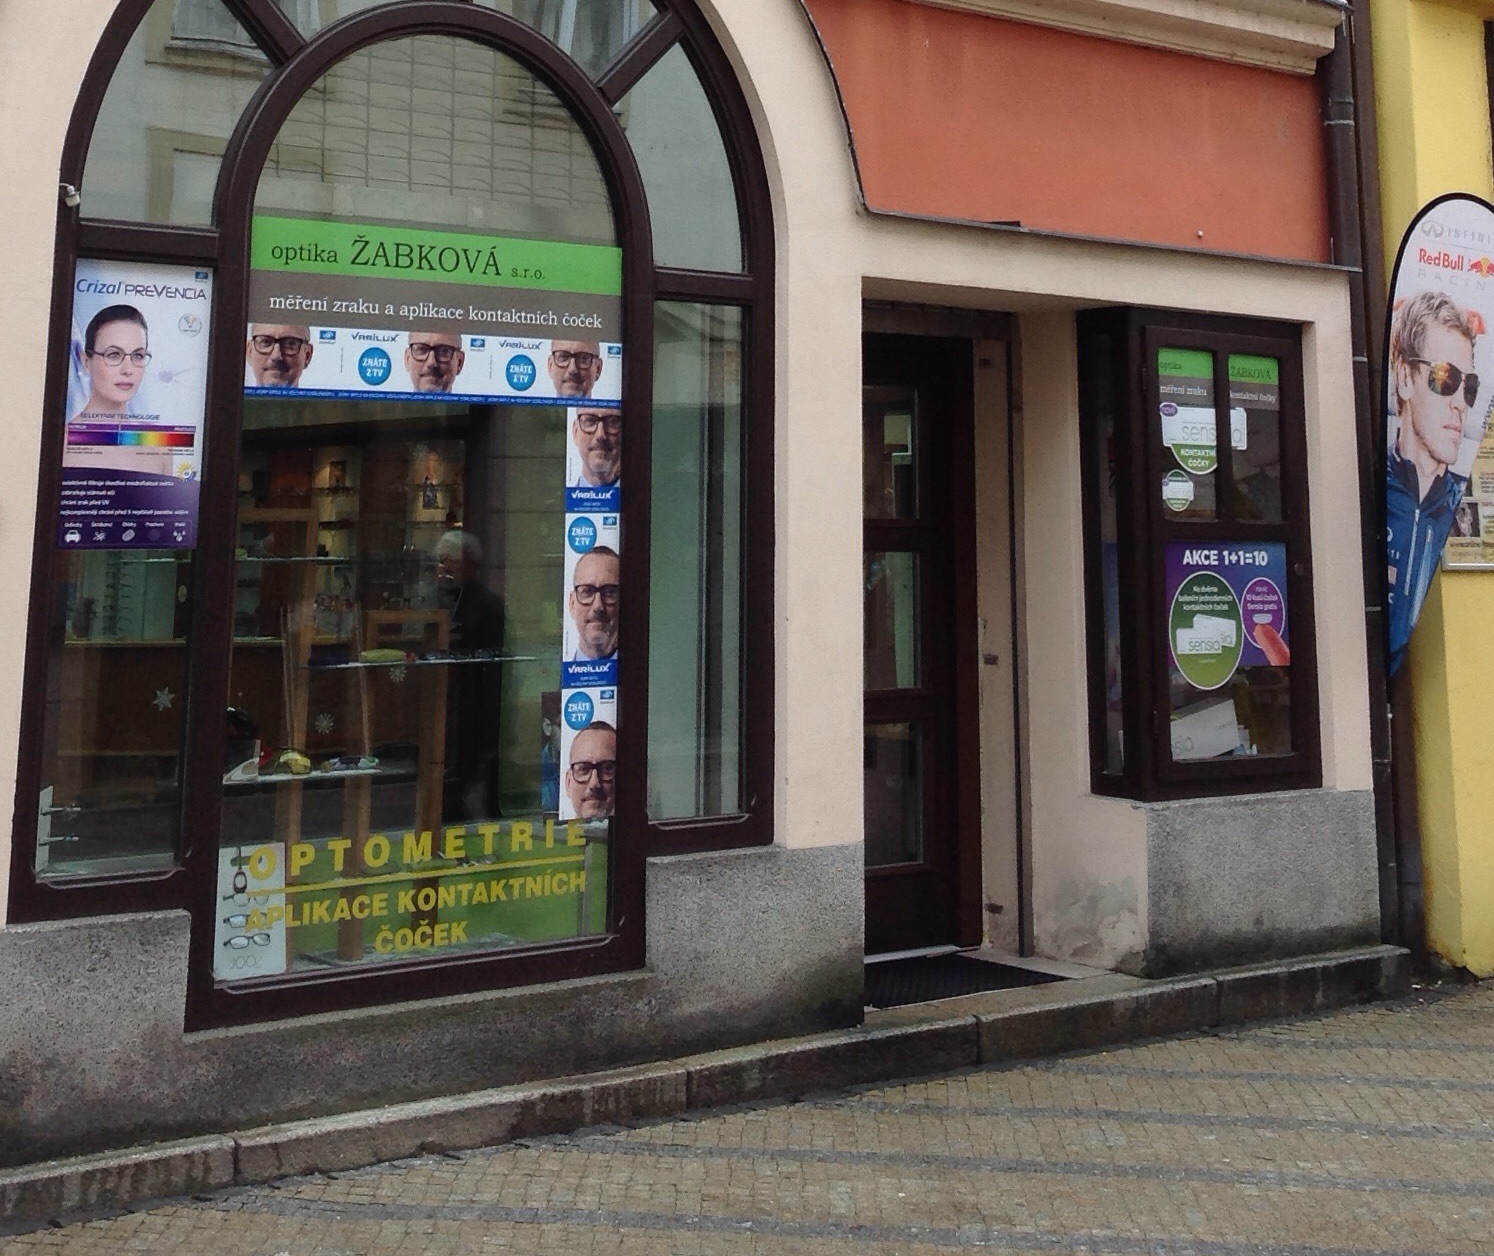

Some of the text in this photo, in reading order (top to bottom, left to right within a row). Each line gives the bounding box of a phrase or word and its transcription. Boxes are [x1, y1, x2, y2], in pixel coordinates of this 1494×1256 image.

[271, 234, 546, 280] optika ŽABKOVÁ s.r.o.
[1419, 248, 1464, 271] Red Bull
[76, 278, 207, 301] Crizal PREVENCIA
[269, 294, 603, 329] měření zraku a aplikace kontaktních čoček
[1183, 549, 1268, 566] AKCE 1+1=10
[568, 662, 610, 674] VARILUX
[249, 819, 587, 881] OPTOMETRIE
[245, 869, 587, 933] APLIKACE KONTAKTNÍCH
[375, 919, 469, 954] ČOČEK
